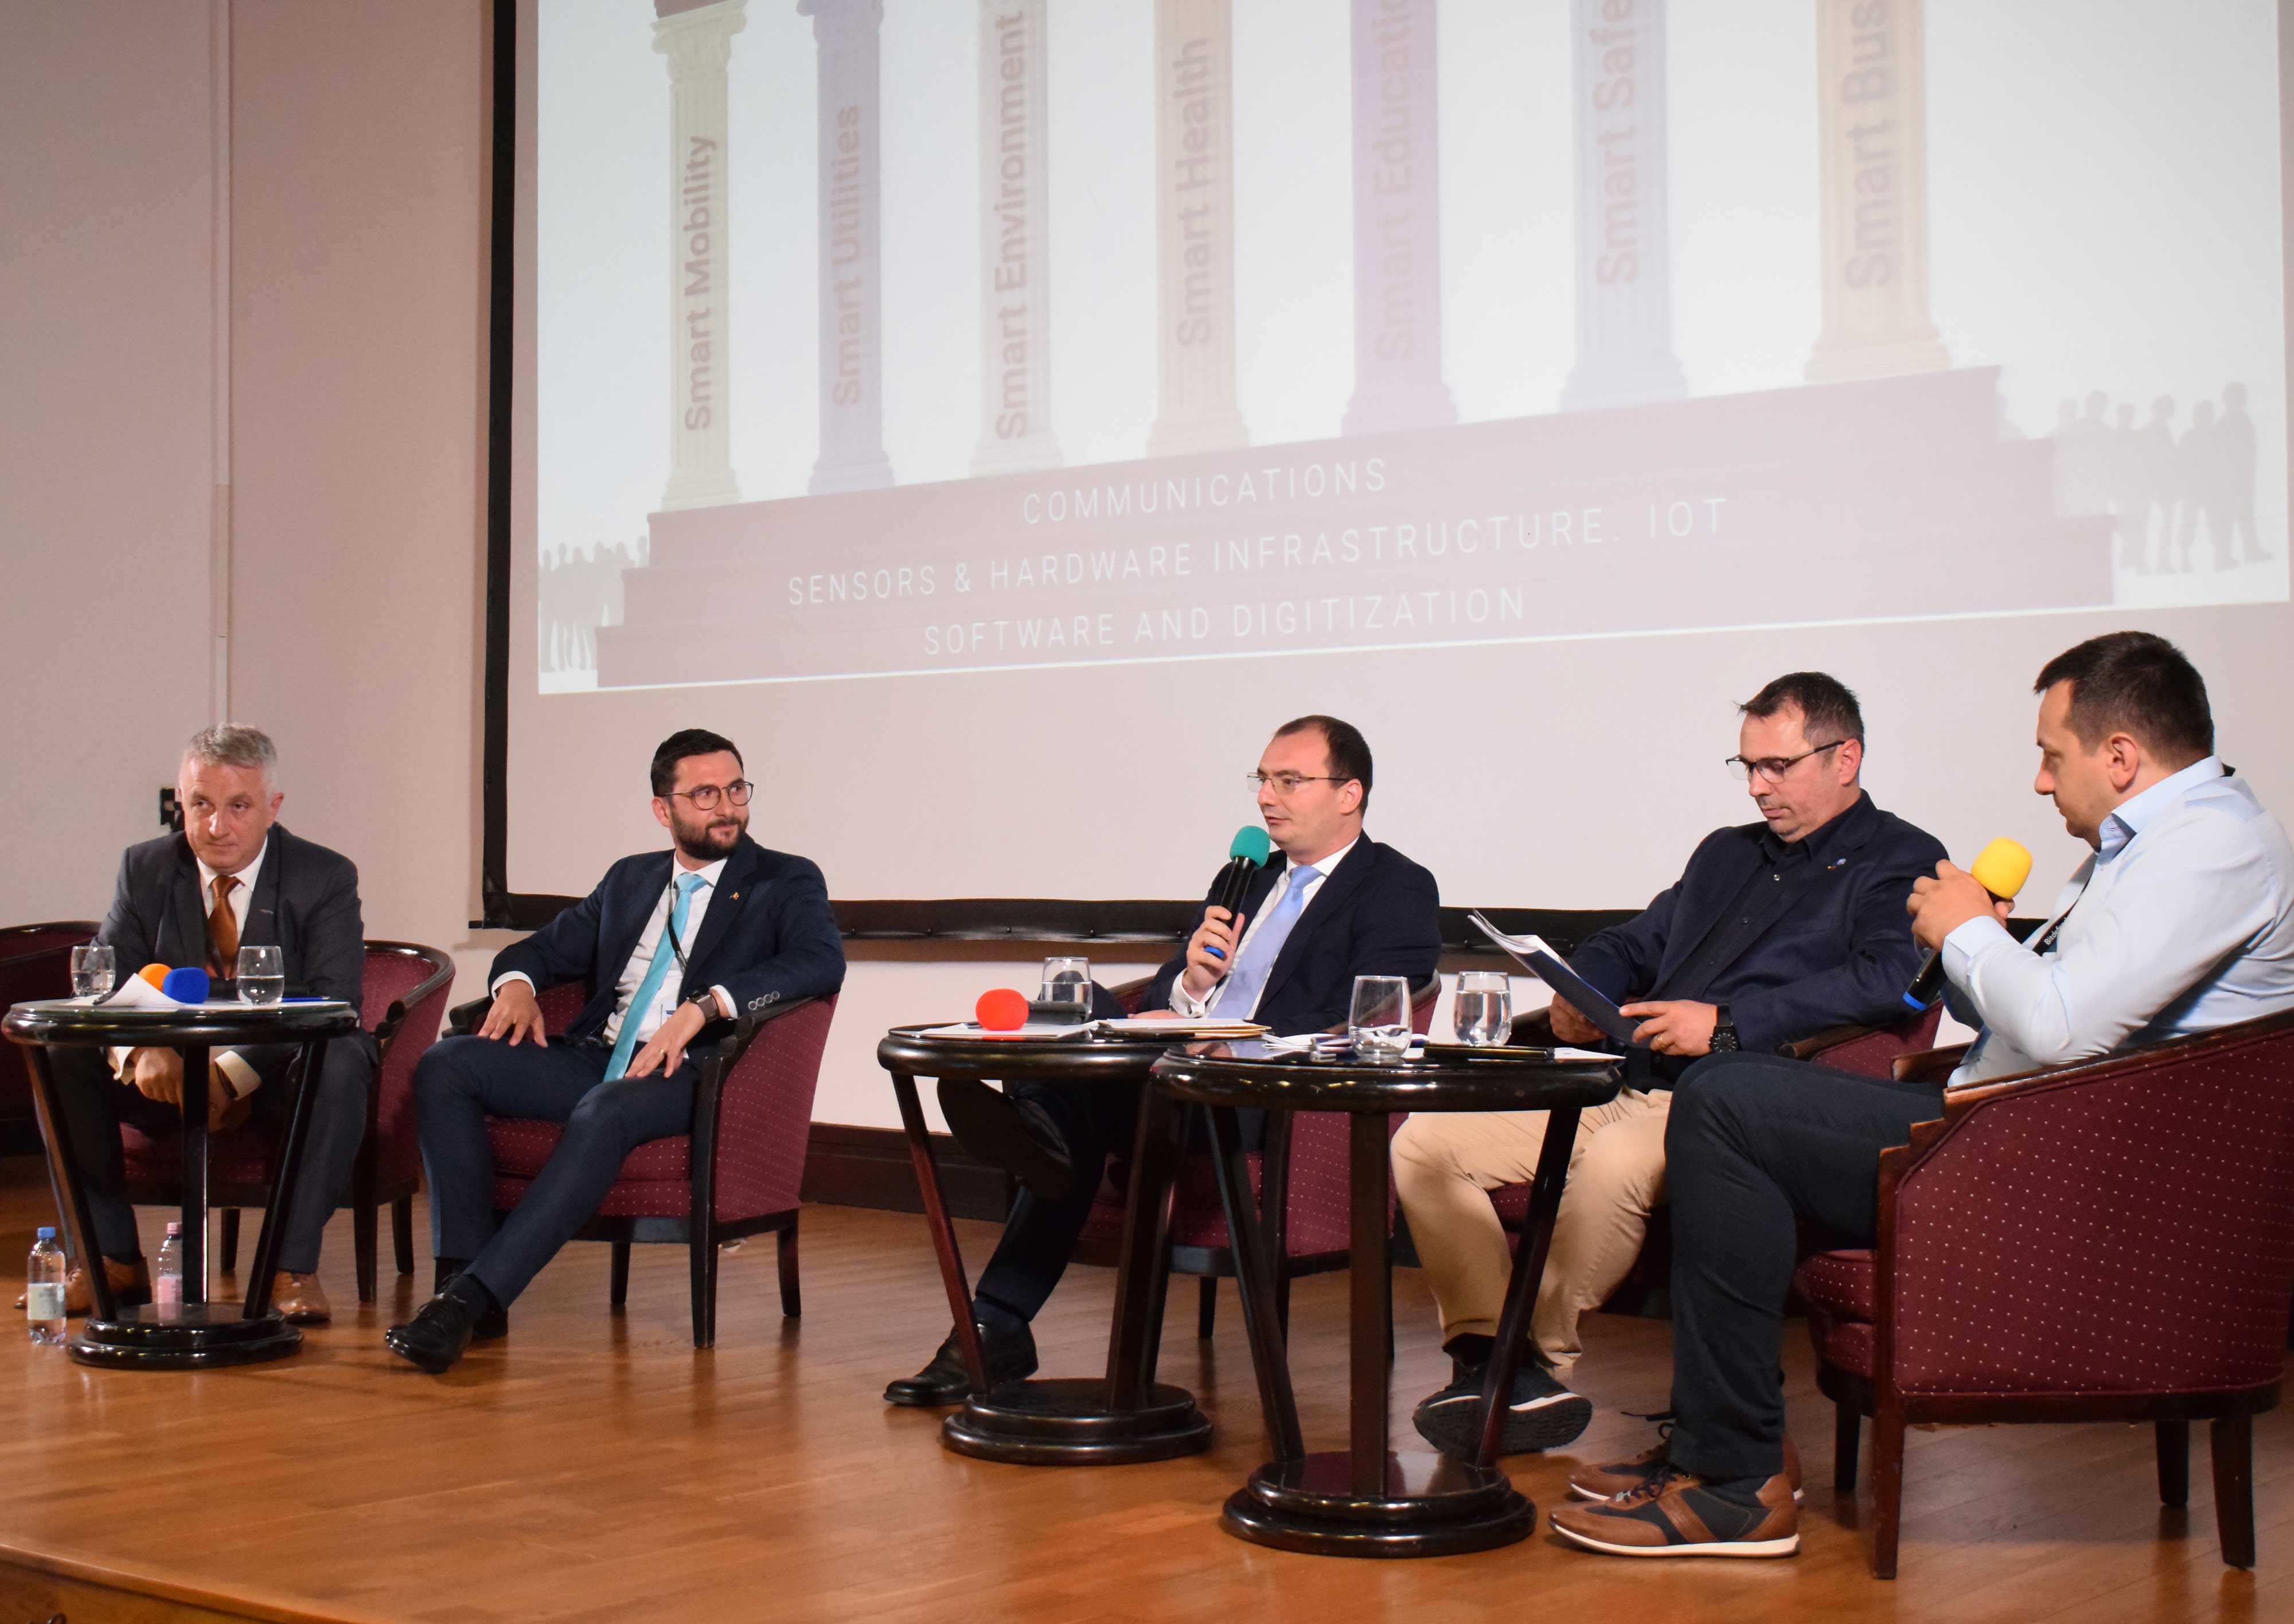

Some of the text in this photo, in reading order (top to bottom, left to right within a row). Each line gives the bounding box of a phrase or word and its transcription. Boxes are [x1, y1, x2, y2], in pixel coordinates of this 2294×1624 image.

[830, 104, 861, 407] Smart Utilities
[993, 11, 1028, 439] Smart Environment
[1173, 38, 1213, 348] Smart Health
[1596, 126, 1638, 285] Smart
[1843, 119, 1893, 289] Smart
[683, 135, 717, 431] Smart Mobility
[1376, 209, 1414, 360] Smart
[788, 566, 935, 606] SENSORS
[954, 563, 972, 593] &
[991, 543, 1191, 590] HARDWARE
[1649, 498, 1726, 539] IOT
[1023, 458, 1385, 524] COMMUNICATIONS
[924, 586, 1524, 655] SOFTWARE AND DIGITIZATION
